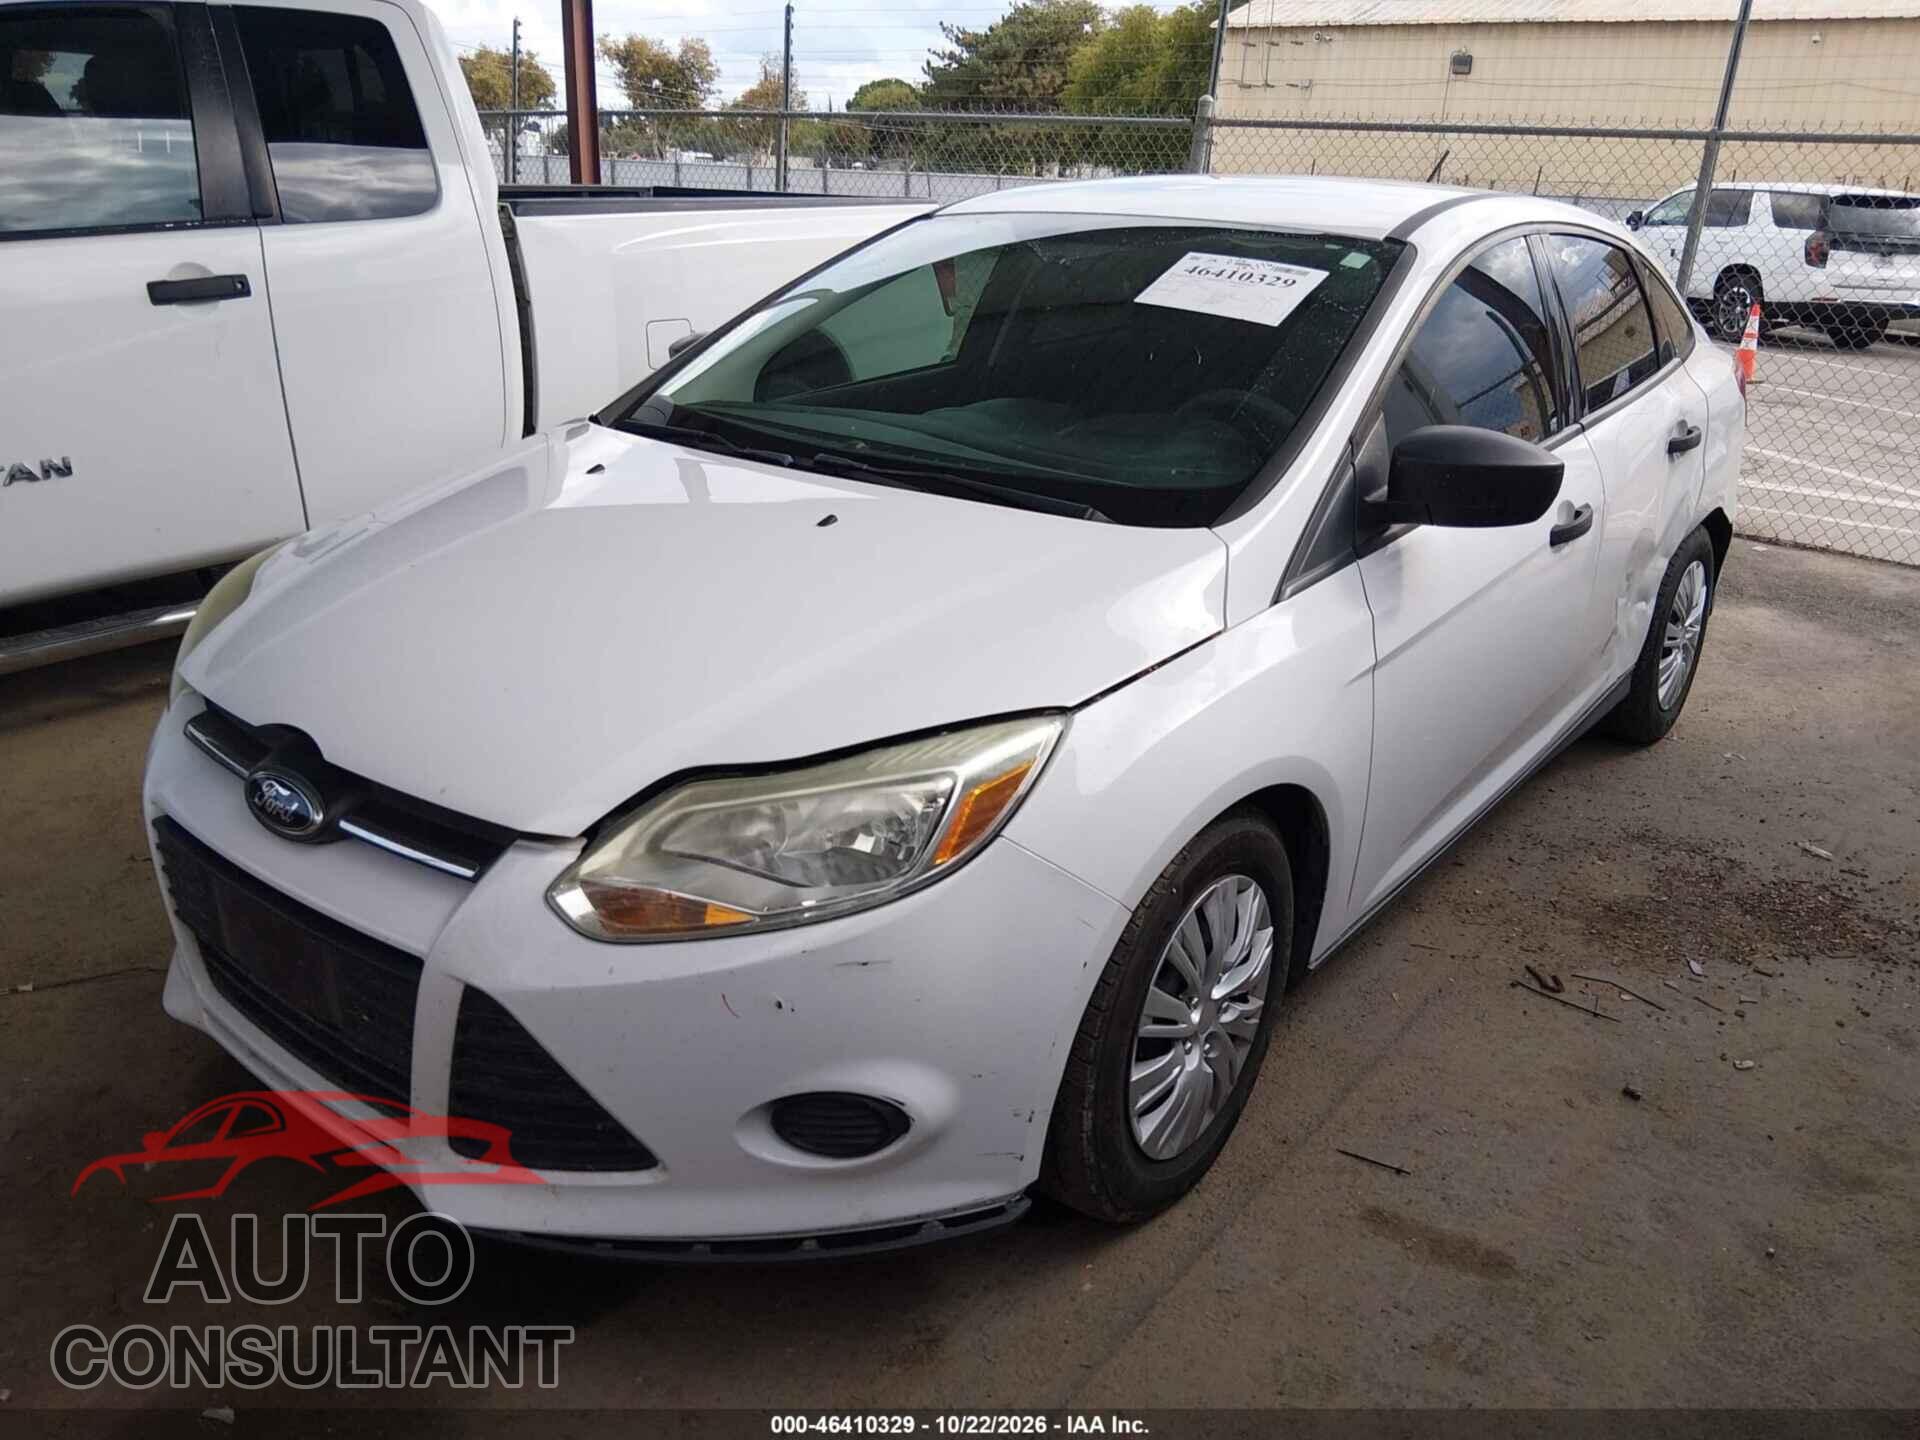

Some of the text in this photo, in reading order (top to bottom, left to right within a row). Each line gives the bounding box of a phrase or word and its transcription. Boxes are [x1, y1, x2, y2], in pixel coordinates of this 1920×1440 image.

[1183, 265, 1297, 288] 46410329
[0, 456, 73, 487] AN
[255, 780, 299, 822] Ford
